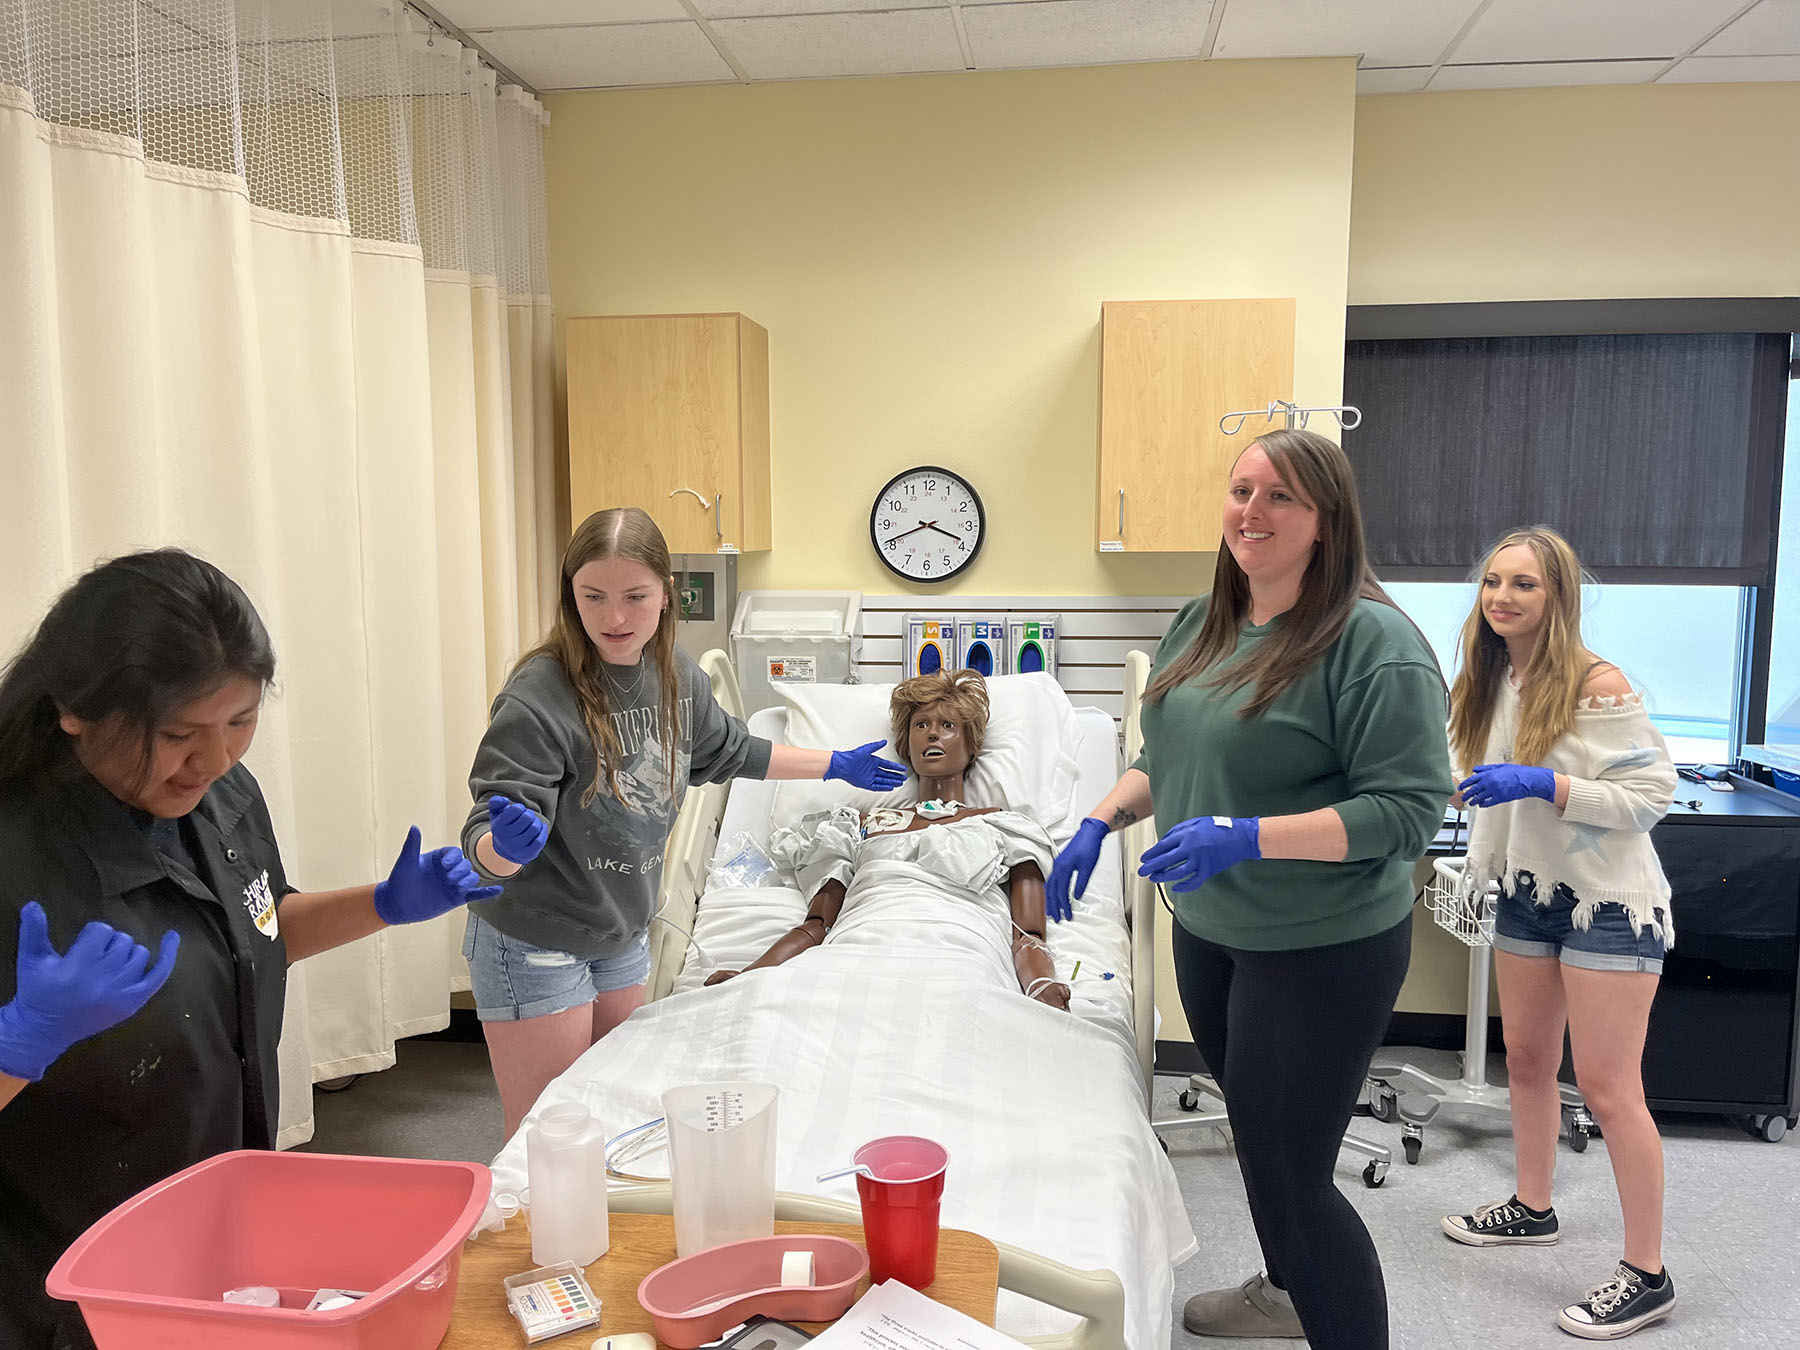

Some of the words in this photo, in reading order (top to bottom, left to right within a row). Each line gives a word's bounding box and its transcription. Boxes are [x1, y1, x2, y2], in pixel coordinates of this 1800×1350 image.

[904, 485, 915, 495] 11
[923, 480, 936, 491] 12
[946, 485, 950, 496] 1
[889, 500, 902, 511] 10
[959, 502, 967, 512] 2
[883, 519, 891, 530] 9
[965, 520, 973, 531] 3
[889, 540, 897, 550] 8
[958, 541, 966, 552] 4
[904, 554, 912, 565] 7
[943, 555, 951, 566] 5
[922, 560, 931, 571] 6
[927, 626, 938, 634] S
[976, 625, 987, 636] M
[1027, 627, 1038, 635] L
[586, 856, 634, 875] LAKE
[640, 852, 664, 875] GEN
